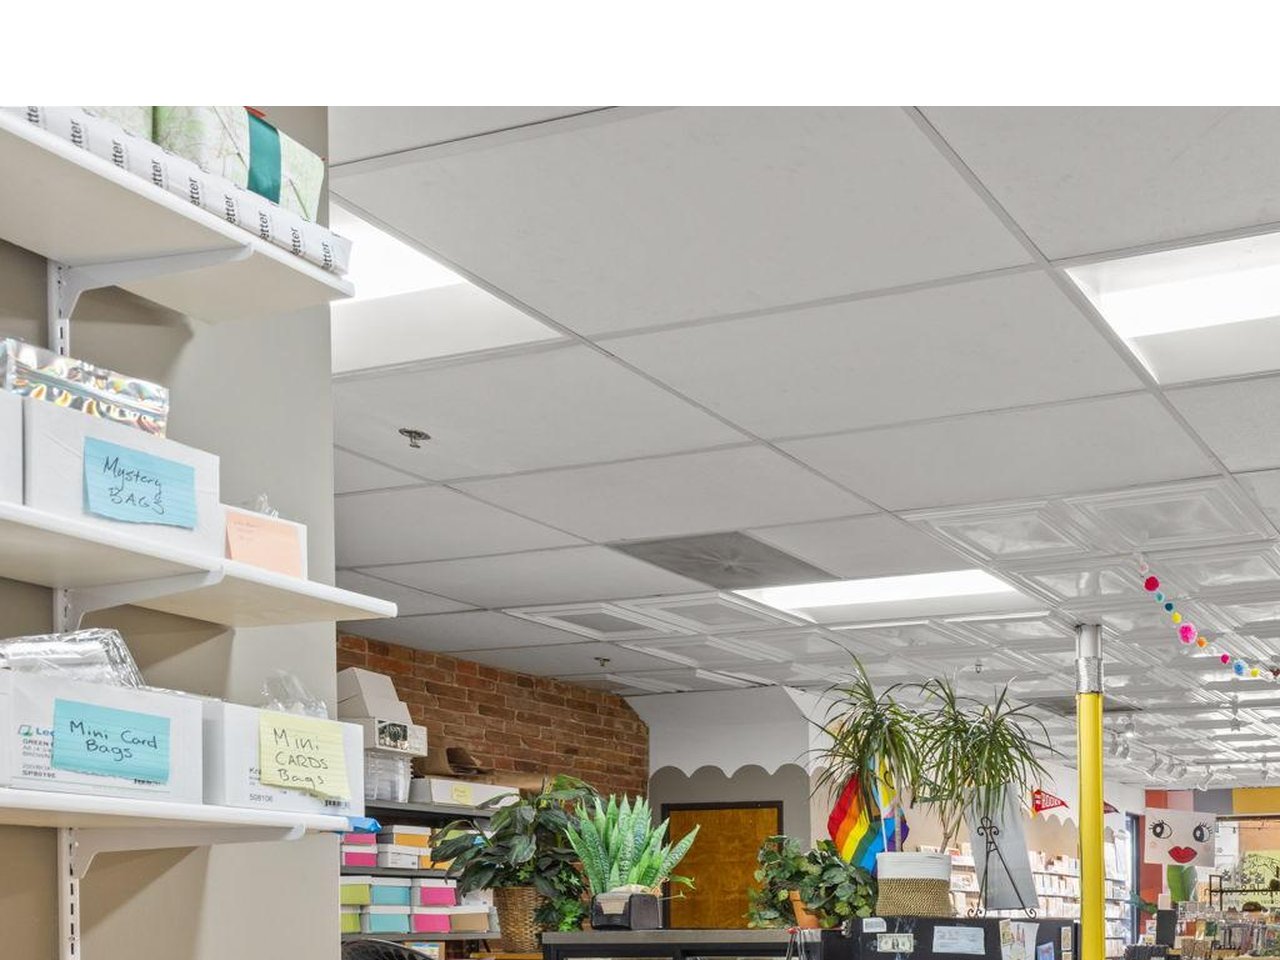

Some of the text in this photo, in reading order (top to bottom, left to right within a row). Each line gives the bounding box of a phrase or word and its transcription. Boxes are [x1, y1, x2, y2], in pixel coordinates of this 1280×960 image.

[103, 456, 162, 500] Mystery
[109, 487, 165, 515] BAGS
[70, 720, 158, 749] Mini Card
[273, 727, 320, 751] Mini
[86, 738, 133, 762] Bags
[274, 751, 329, 769] CARDS
[277, 768, 324, 791] Bags
